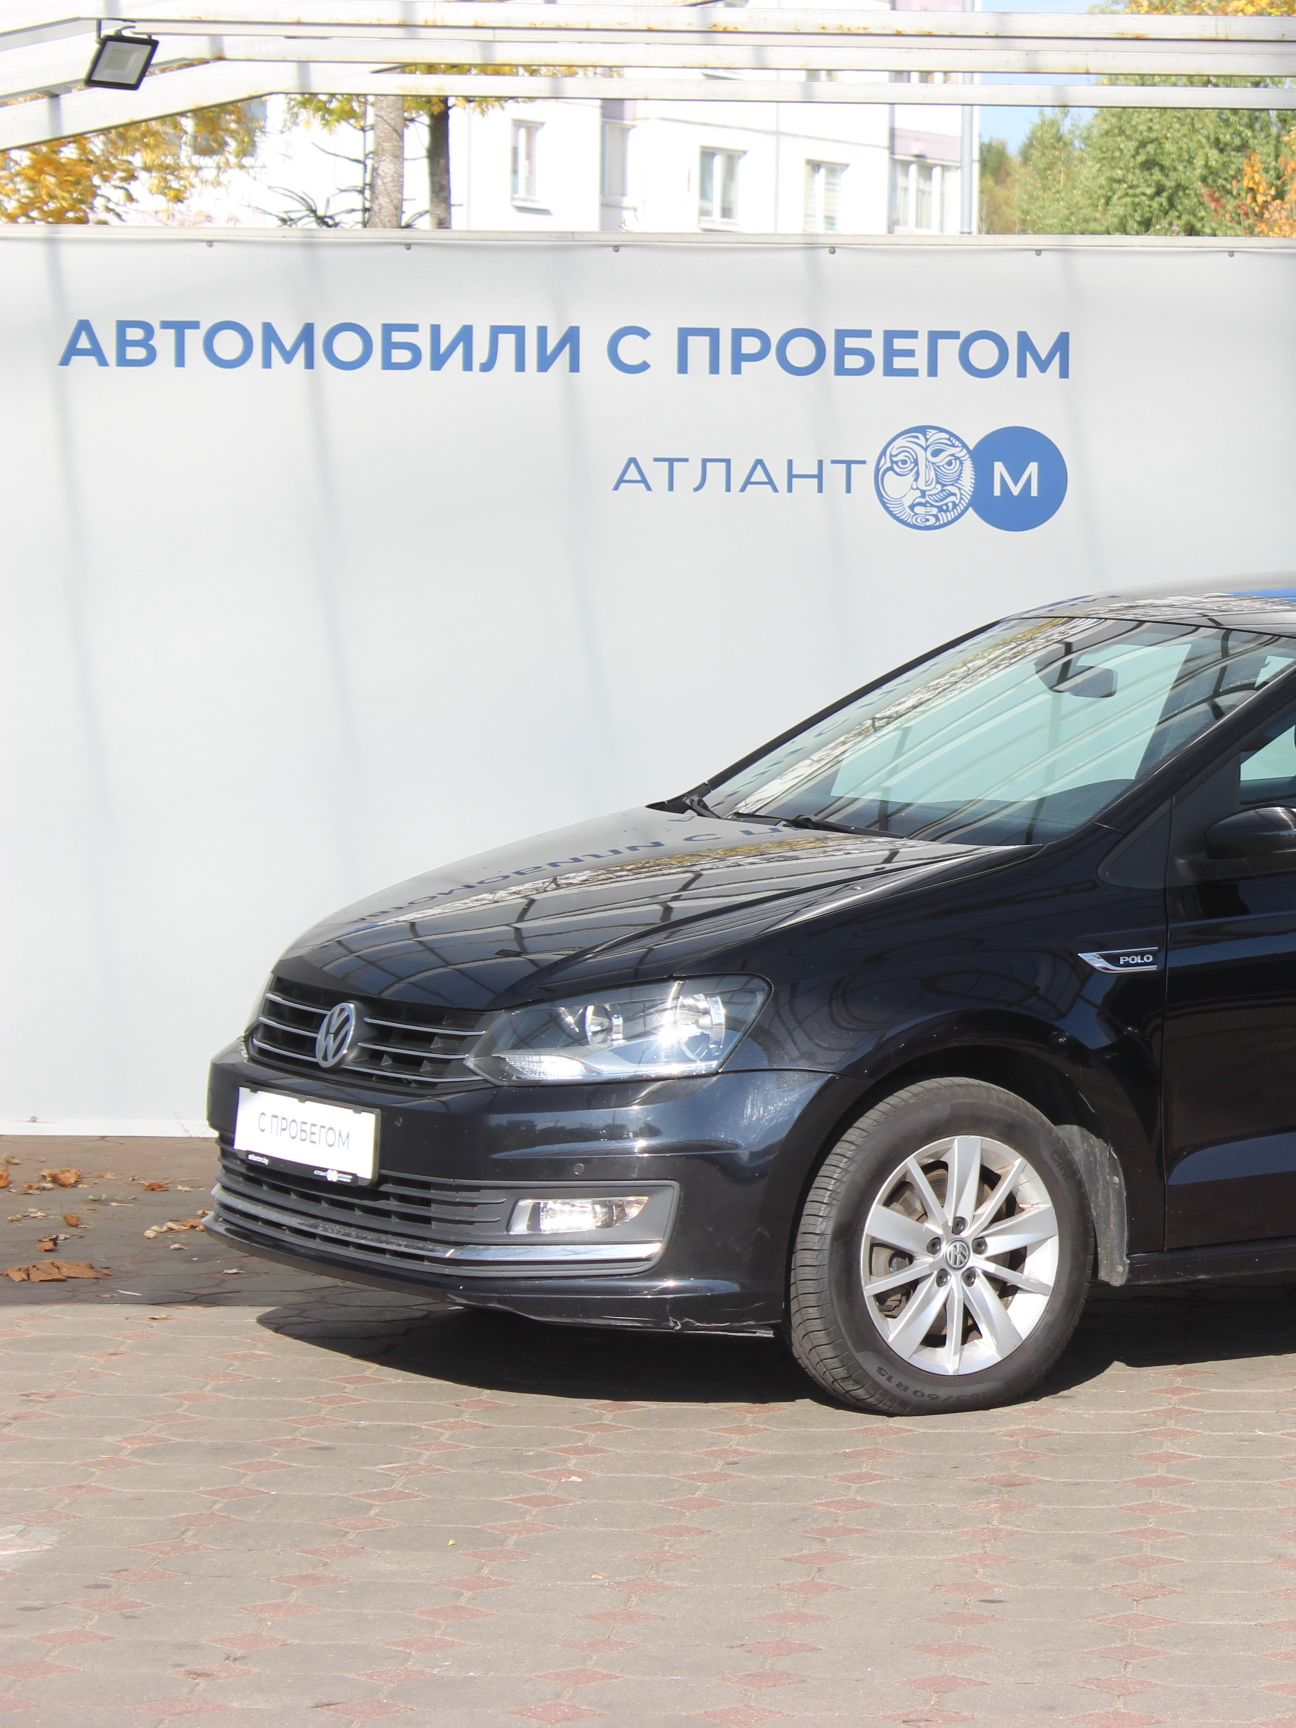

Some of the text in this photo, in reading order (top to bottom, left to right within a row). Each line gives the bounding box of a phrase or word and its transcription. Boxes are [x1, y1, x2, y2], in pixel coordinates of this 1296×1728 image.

[59, 319, 1071, 380] АВТОМОБИЛИ С ПРОБЕГОМ
[612, 457, 868, 495] АТЛАНТ
[1119, 954, 1154, 965] POLO
[257, 1111, 351, 1152] С ПРОБЕГОМ
